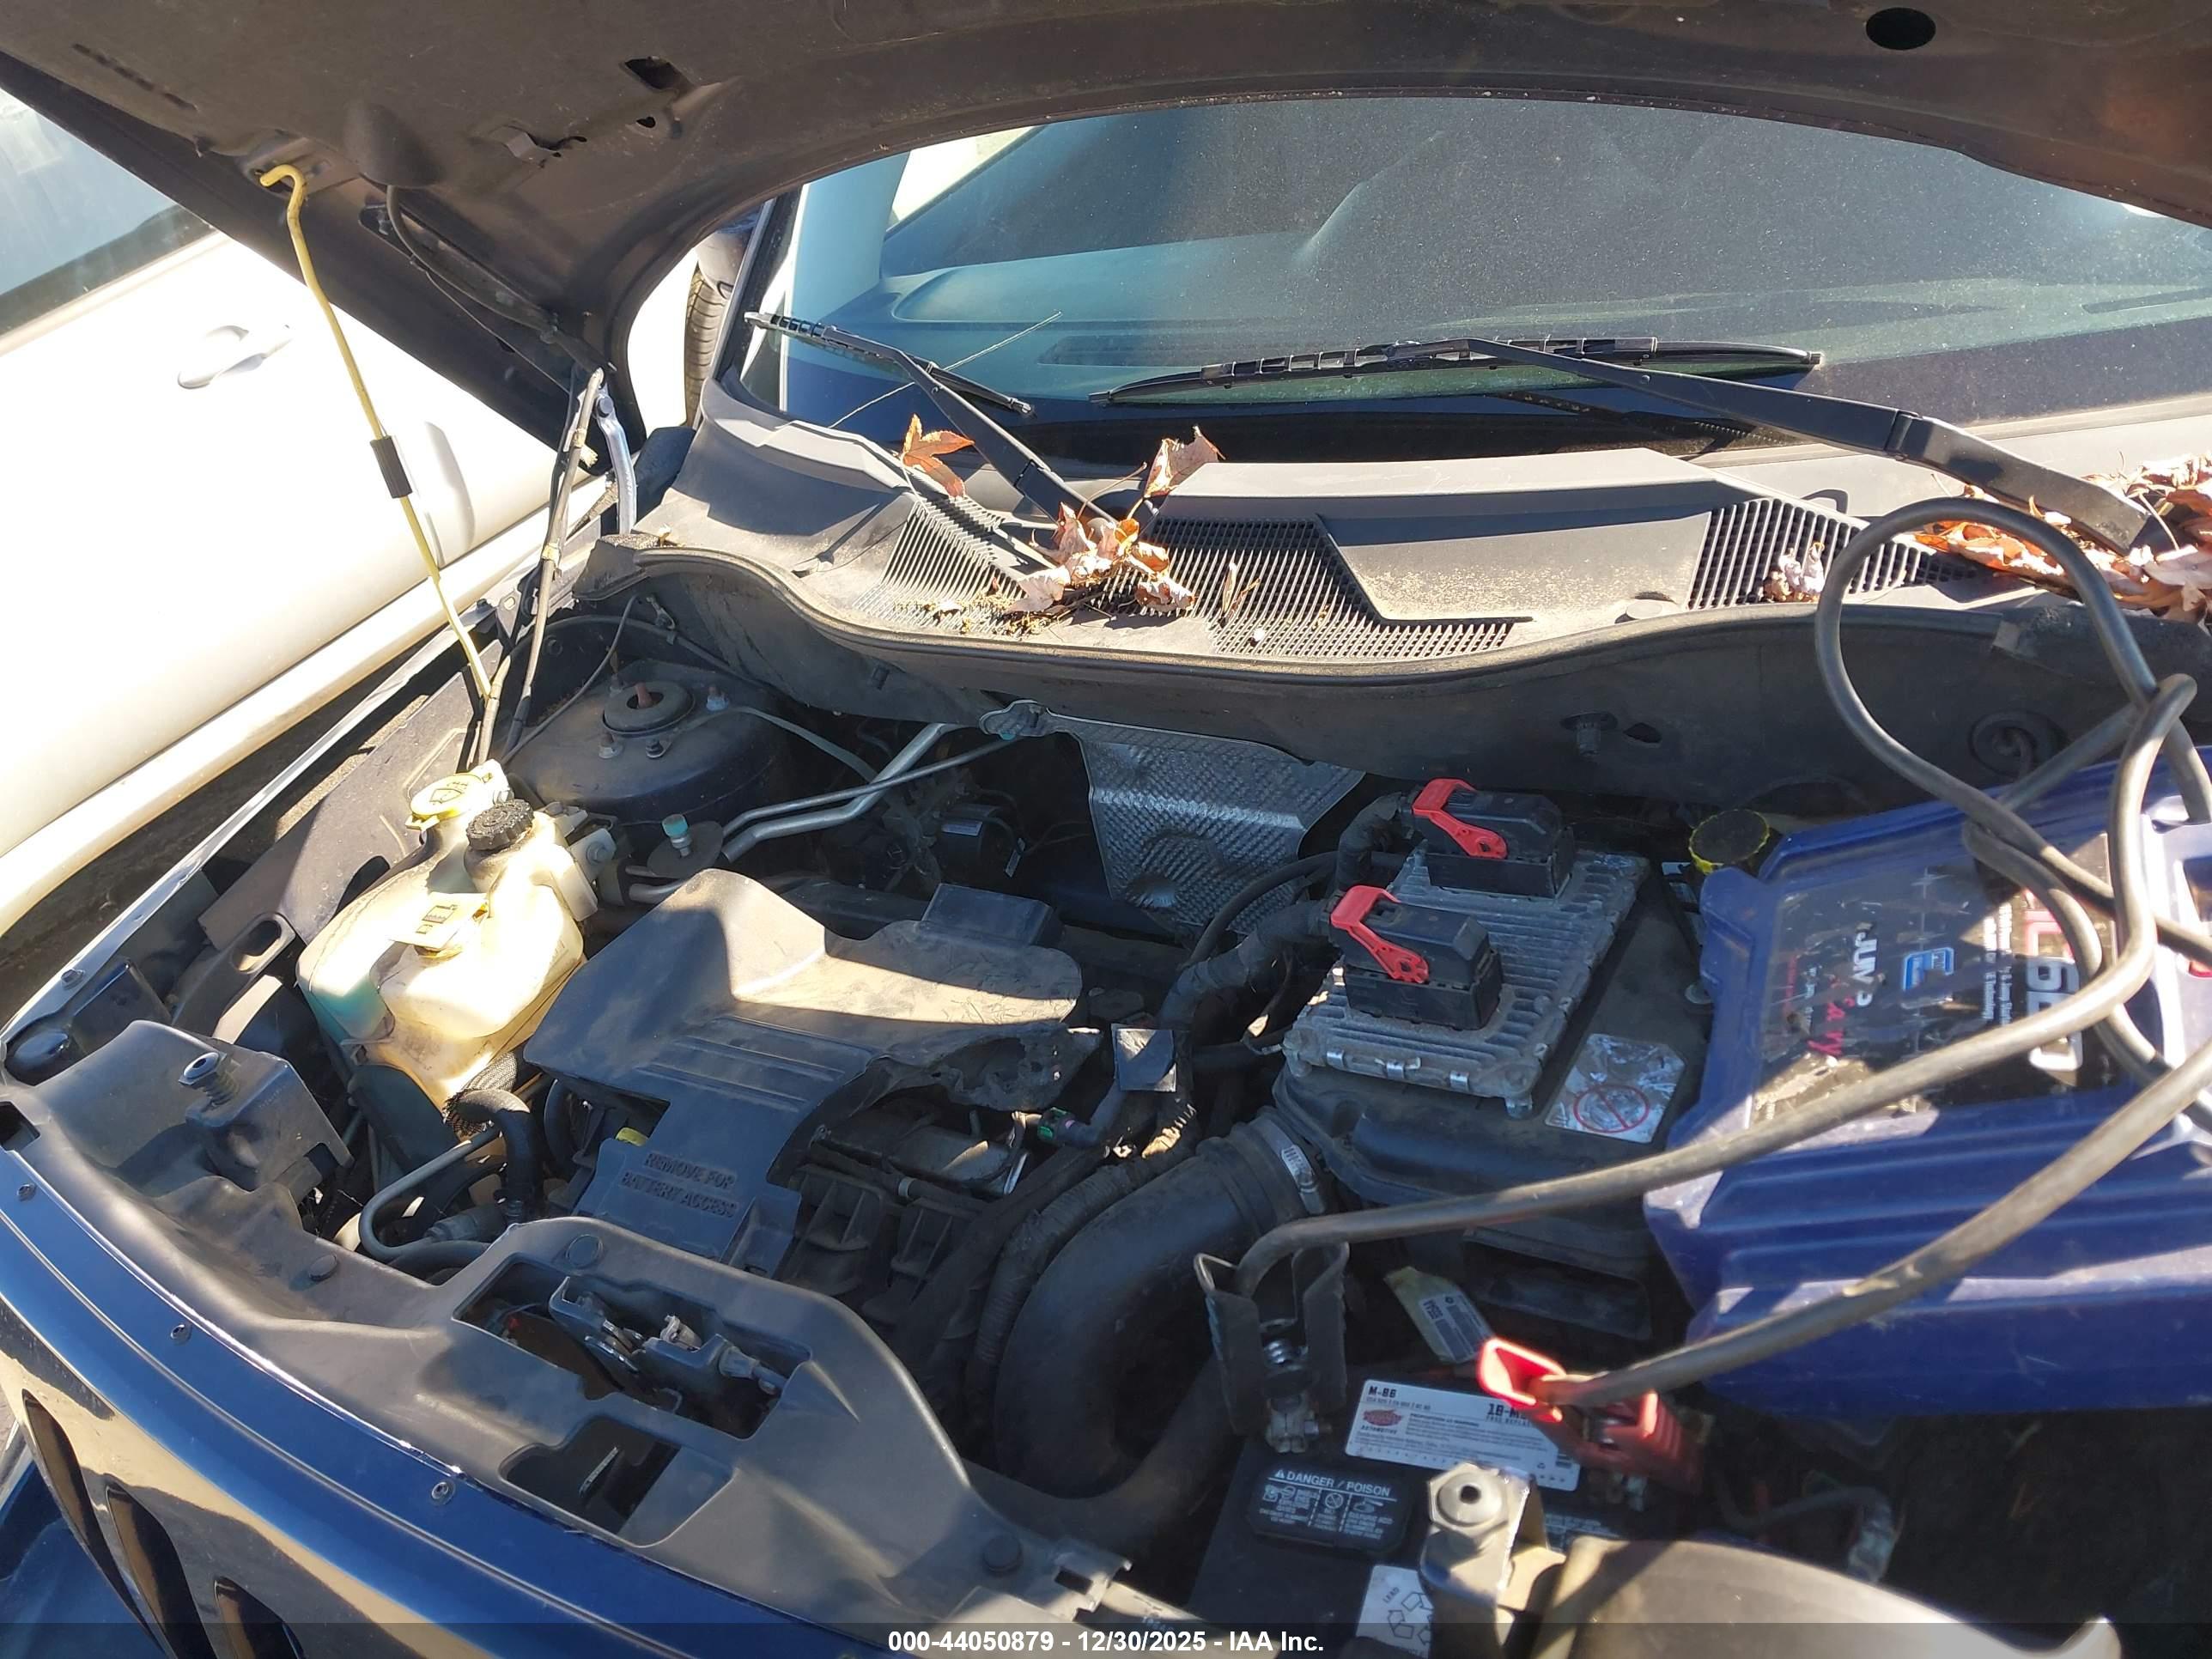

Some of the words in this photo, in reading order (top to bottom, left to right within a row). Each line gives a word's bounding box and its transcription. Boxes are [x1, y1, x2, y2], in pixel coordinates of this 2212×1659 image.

[644, 1152, 702, 1182] REMOVE
[703, 1170, 736, 1189] FOR
[621, 1170, 683, 1201] BATTERY
[680, 1193, 737, 1218] ACCESS
[1286, 1470, 1334, 1488] DANGER
[1346, 1480, 1392, 1498] POISON
